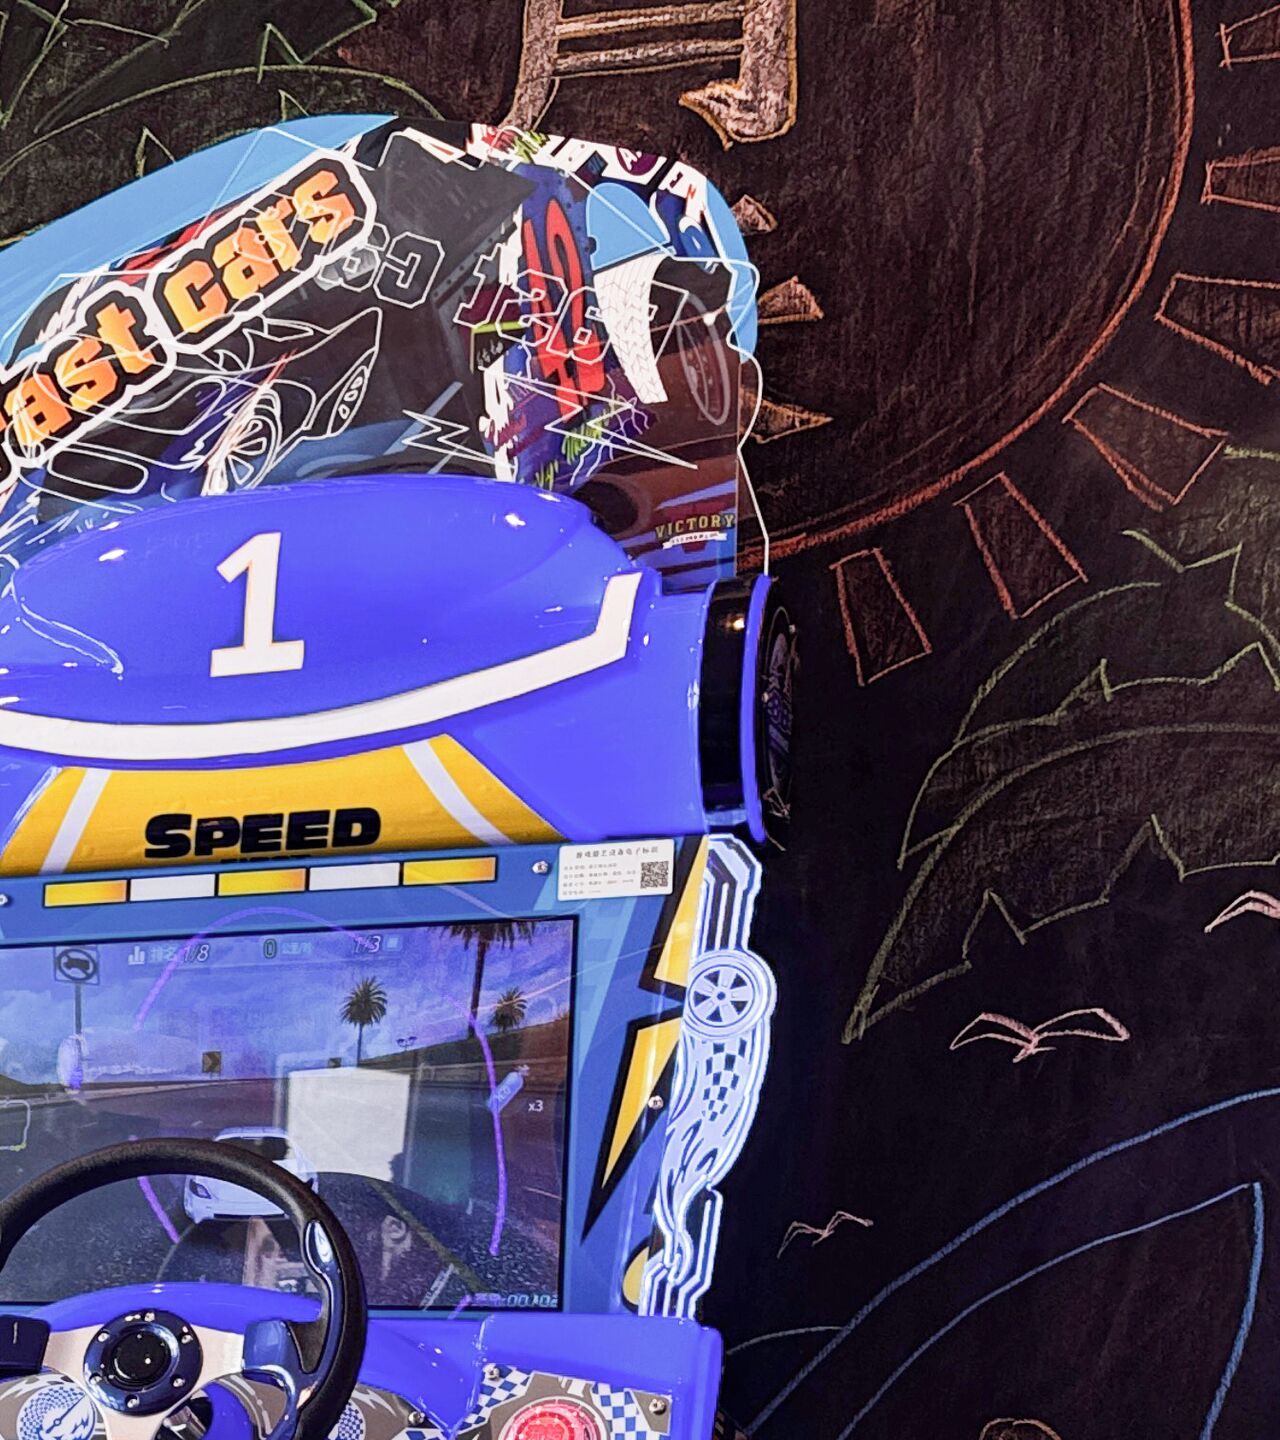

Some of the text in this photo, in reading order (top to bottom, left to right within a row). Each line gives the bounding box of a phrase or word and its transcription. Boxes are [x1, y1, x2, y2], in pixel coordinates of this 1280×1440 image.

[163, 169, 356, 334] cars
[655, 514, 734, 538] VICTORY
[209, 531, 304, 677] 1
[144, 807, 381, 858] SPEED
